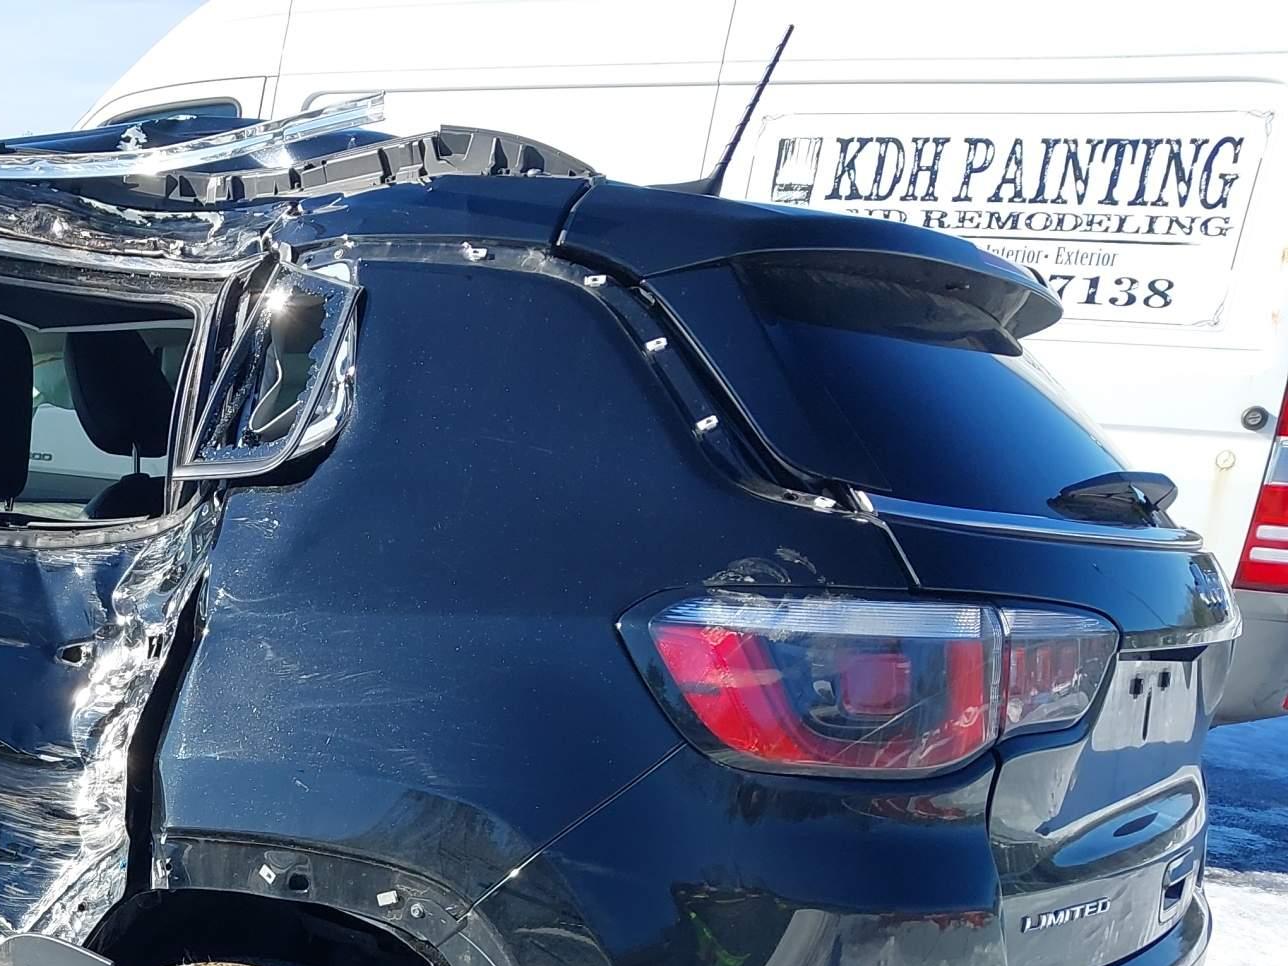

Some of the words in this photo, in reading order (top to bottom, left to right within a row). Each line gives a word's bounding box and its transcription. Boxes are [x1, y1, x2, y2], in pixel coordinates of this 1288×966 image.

[825, 136, 951, 201] KDH
[952, 136, 1244, 210] PAINTING
[919, 208, 1234, 238] REMODELING
[1055, 246, 1119, 268] Exterior
[1021, 897, 1112, 934] LIMITED
